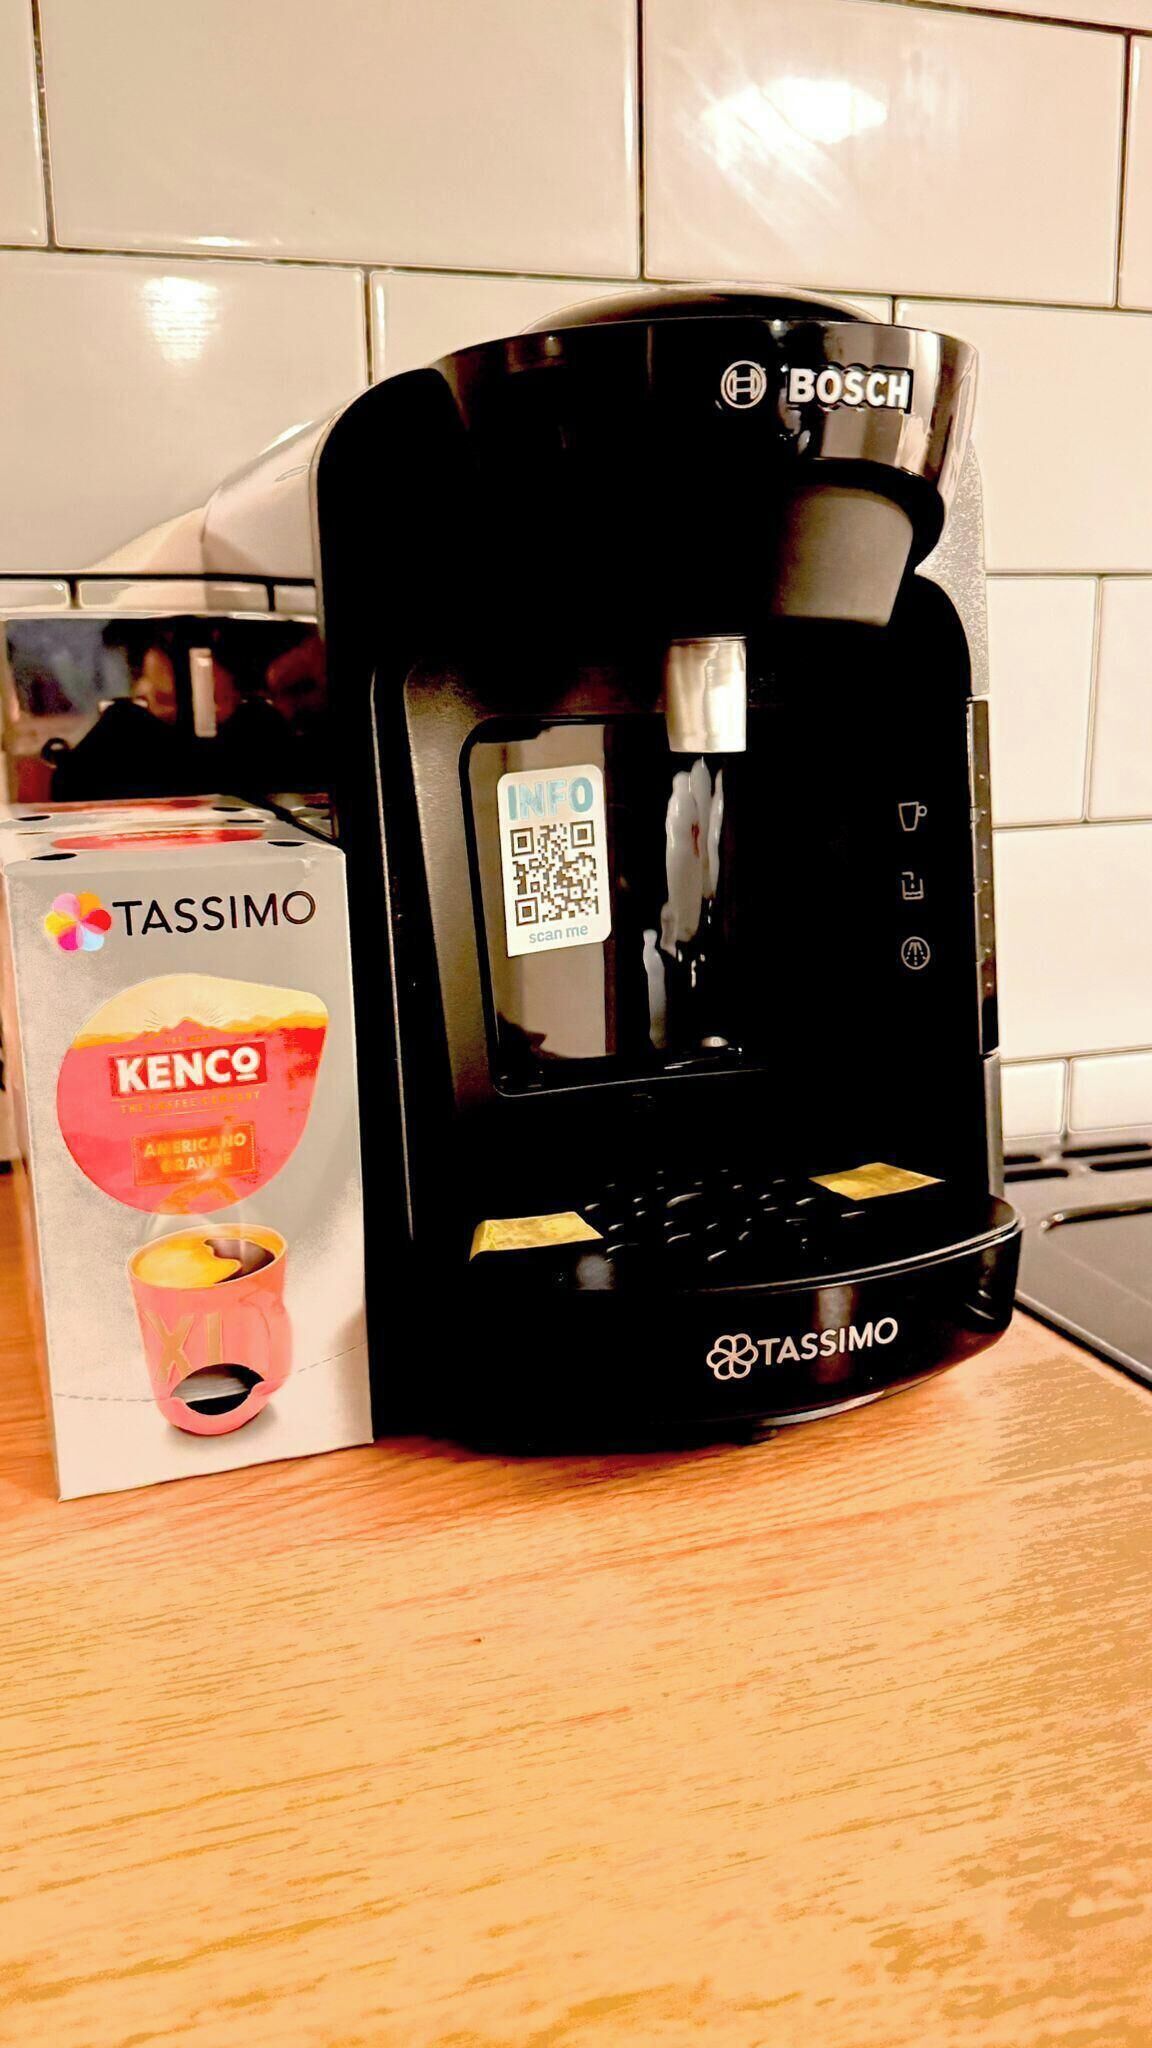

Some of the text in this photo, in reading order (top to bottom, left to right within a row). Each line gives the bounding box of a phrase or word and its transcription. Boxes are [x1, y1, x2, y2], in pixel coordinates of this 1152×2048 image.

[788, 367, 911, 410] BOSCH
[507, 776, 594, 821] INFO
[112, 890, 316, 936] TASSIMO
[528, 924, 589, 944] scan me
[115, 1045, 261, 1094] KENCO
[757, 1316, 899, 1366] TASSIMO
